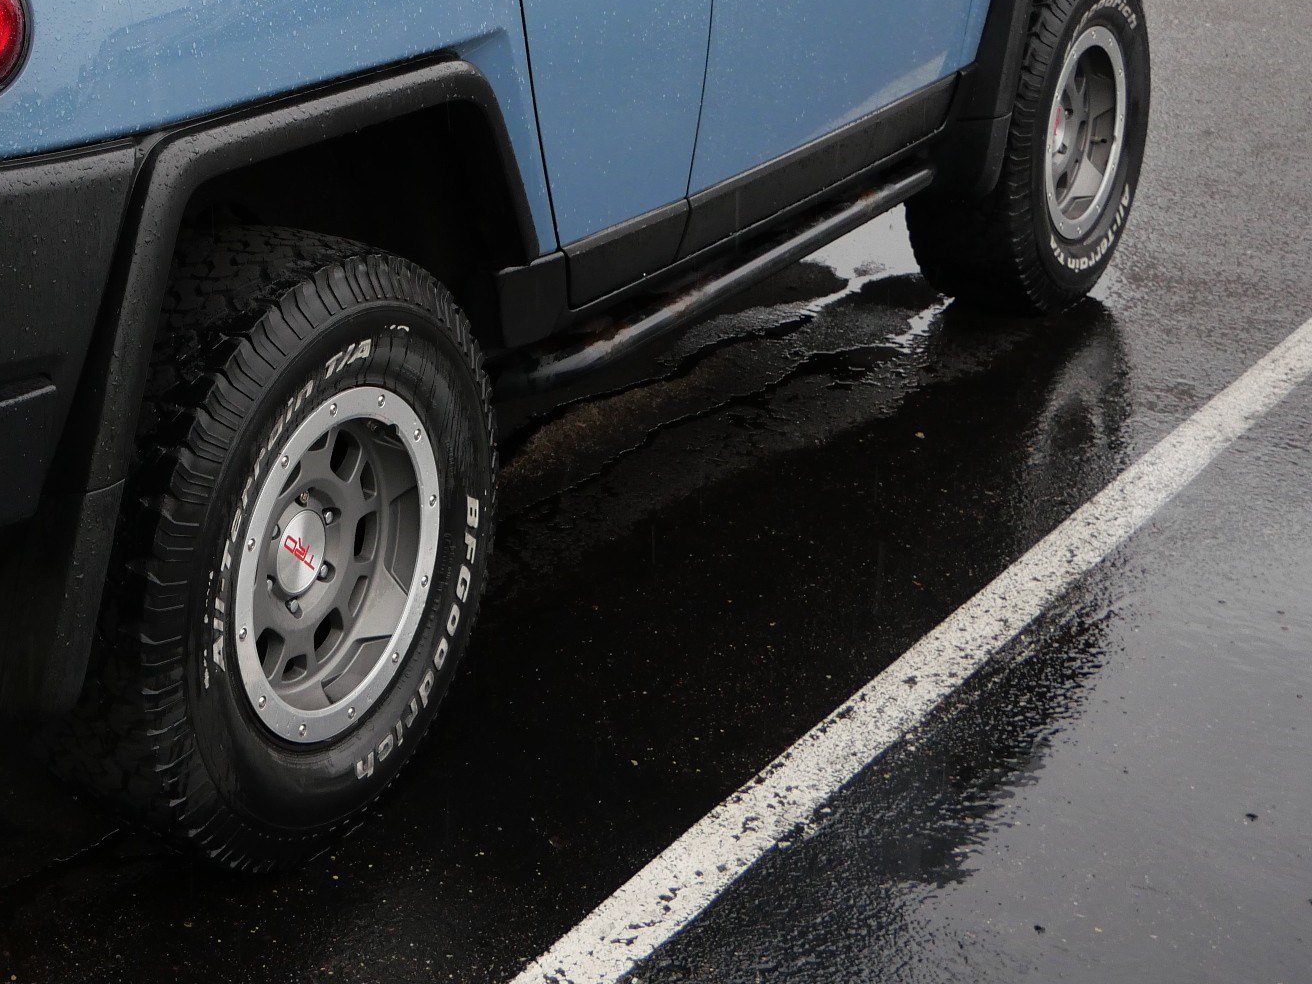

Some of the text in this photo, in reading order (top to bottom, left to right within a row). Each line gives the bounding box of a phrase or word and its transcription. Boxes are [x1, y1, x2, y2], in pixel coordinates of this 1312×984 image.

[1066, 183, 1129, 272] All-Terrain
[211, 338, 372, 672] All-Terrain T/A
[284, 534, 317, 572] TRD
[354, 495, 479, 780] BFGoodrich
